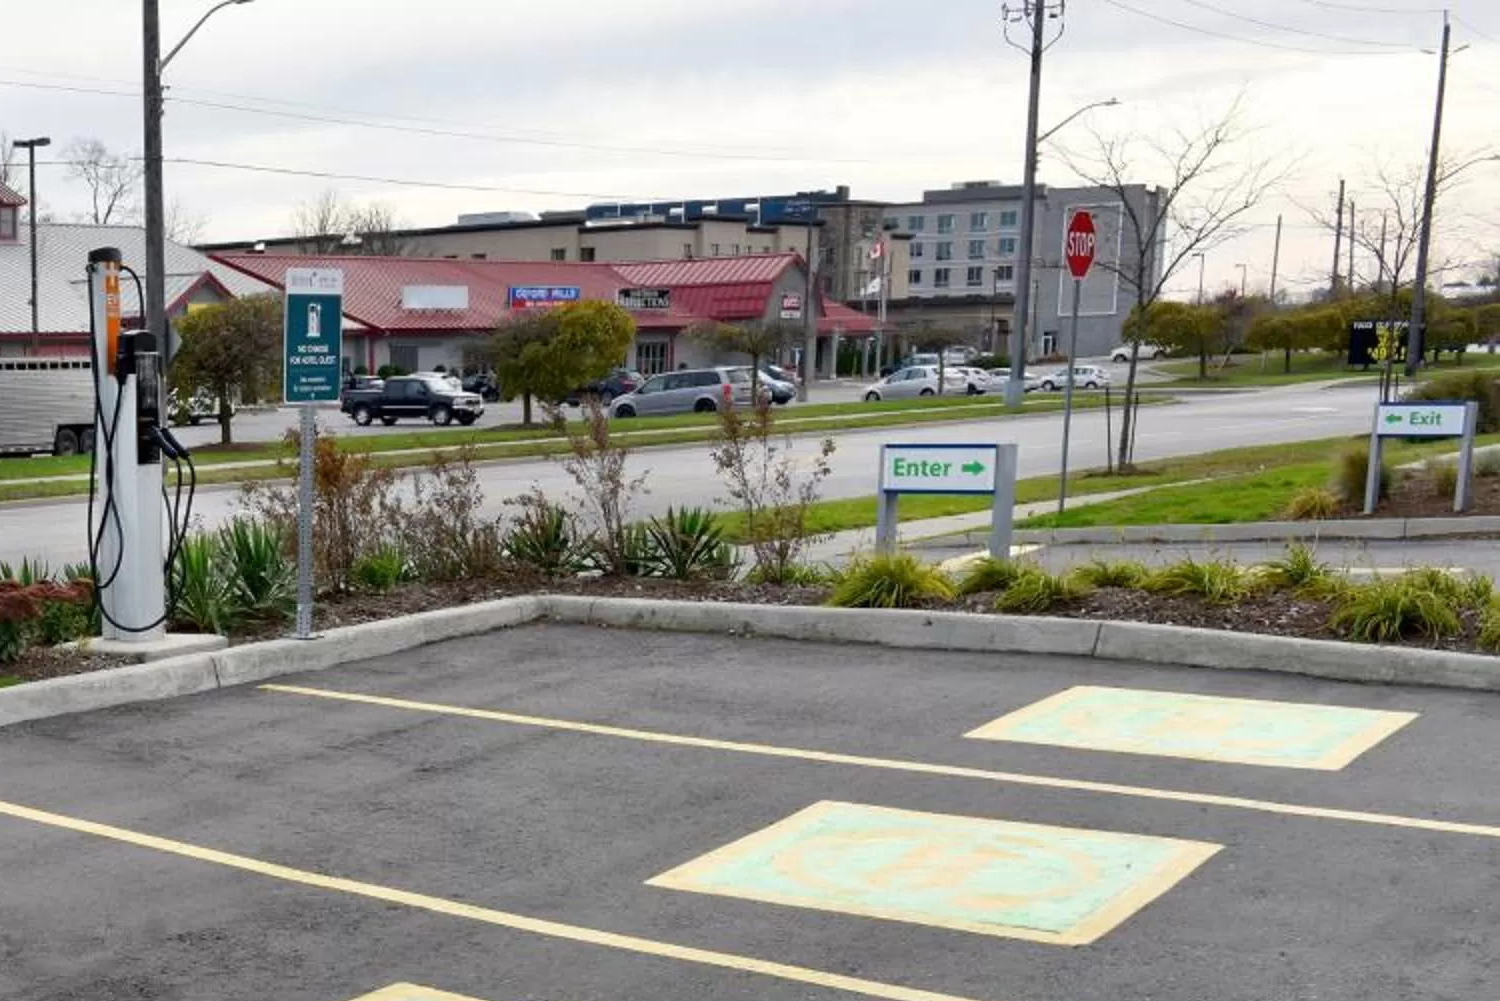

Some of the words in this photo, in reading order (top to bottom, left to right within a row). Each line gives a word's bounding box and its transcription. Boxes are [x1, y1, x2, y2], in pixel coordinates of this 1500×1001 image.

[1067, 231, 1095, 257] STOP
[1409, 411, 1444, 426] Exit
[893, 457, 953, 477] Enter
